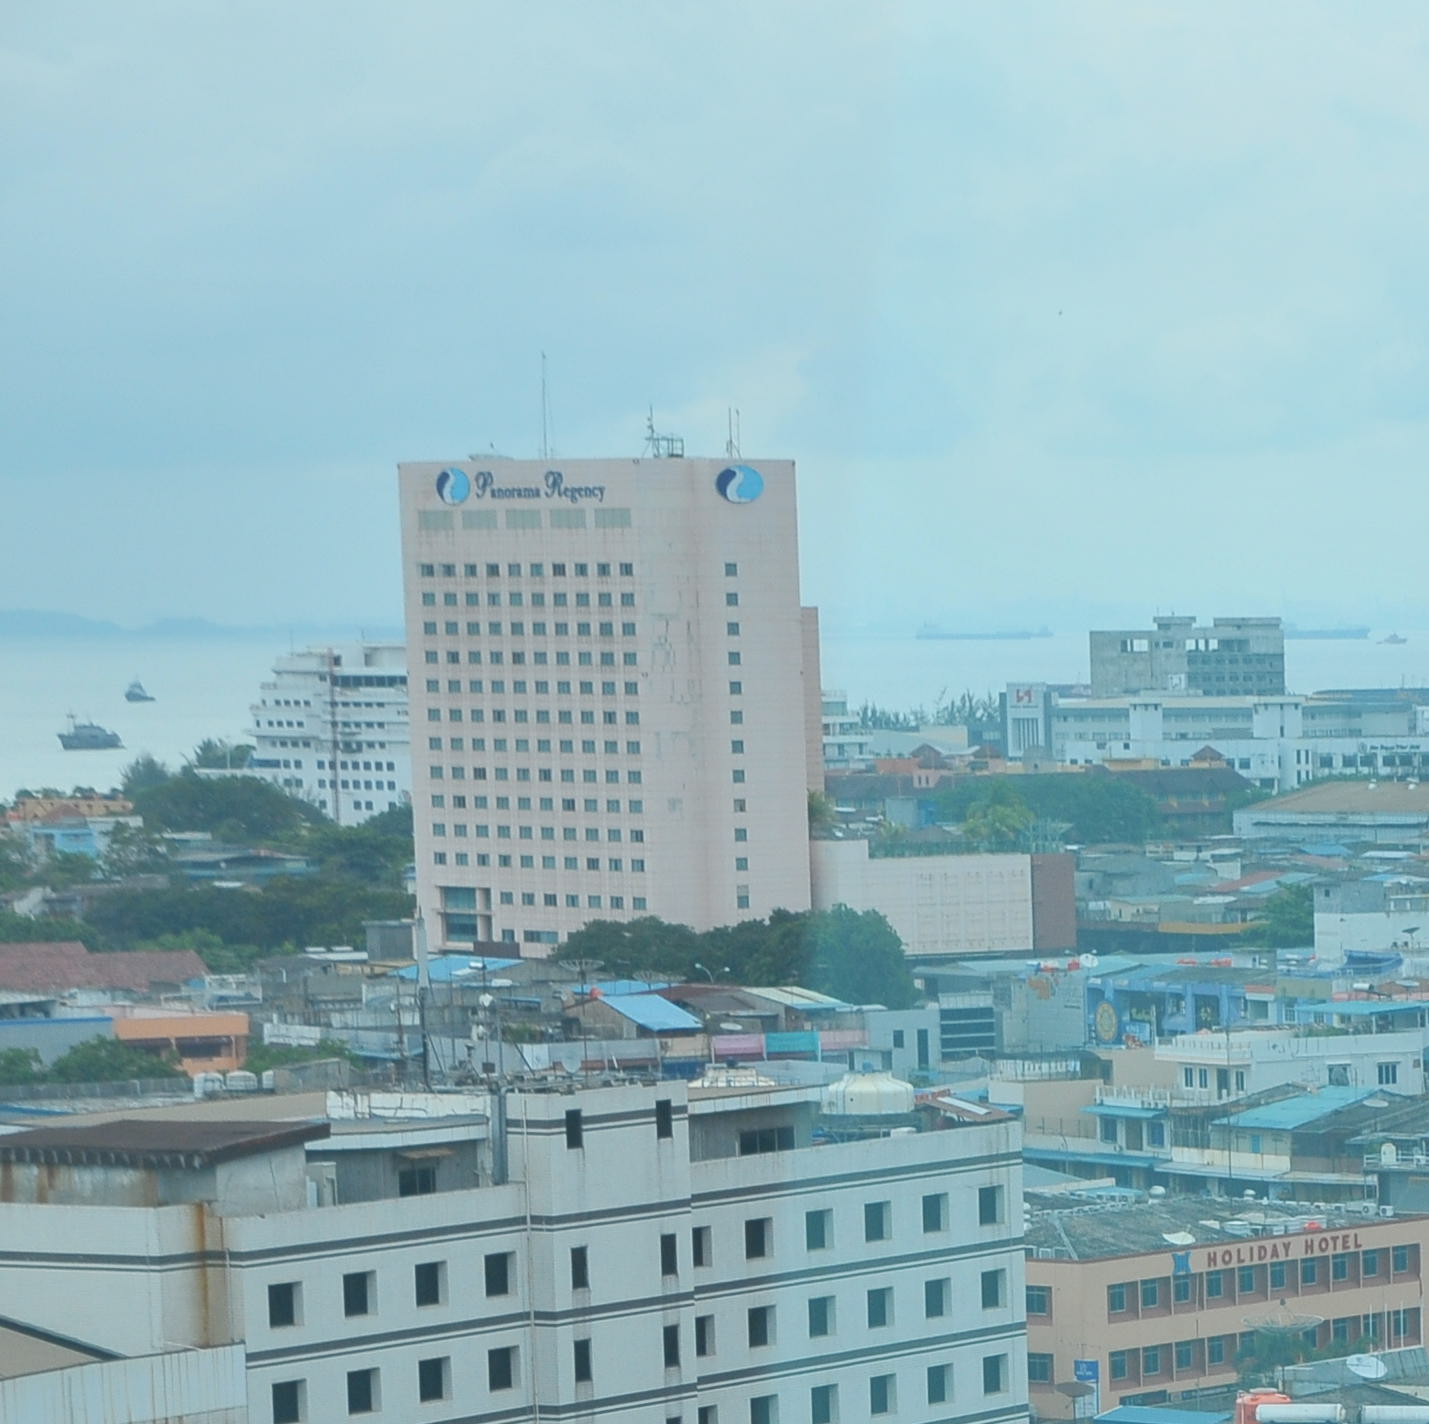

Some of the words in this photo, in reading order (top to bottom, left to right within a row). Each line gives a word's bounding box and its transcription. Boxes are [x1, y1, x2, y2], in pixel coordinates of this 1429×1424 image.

[475, 471, 540, 498] Panorama
[544, 471, 605, 503] Regency
[1207, 1241, 1291, 1268] HOLIDAY
[1304, 1232, 1362, 1255] HOTEL
